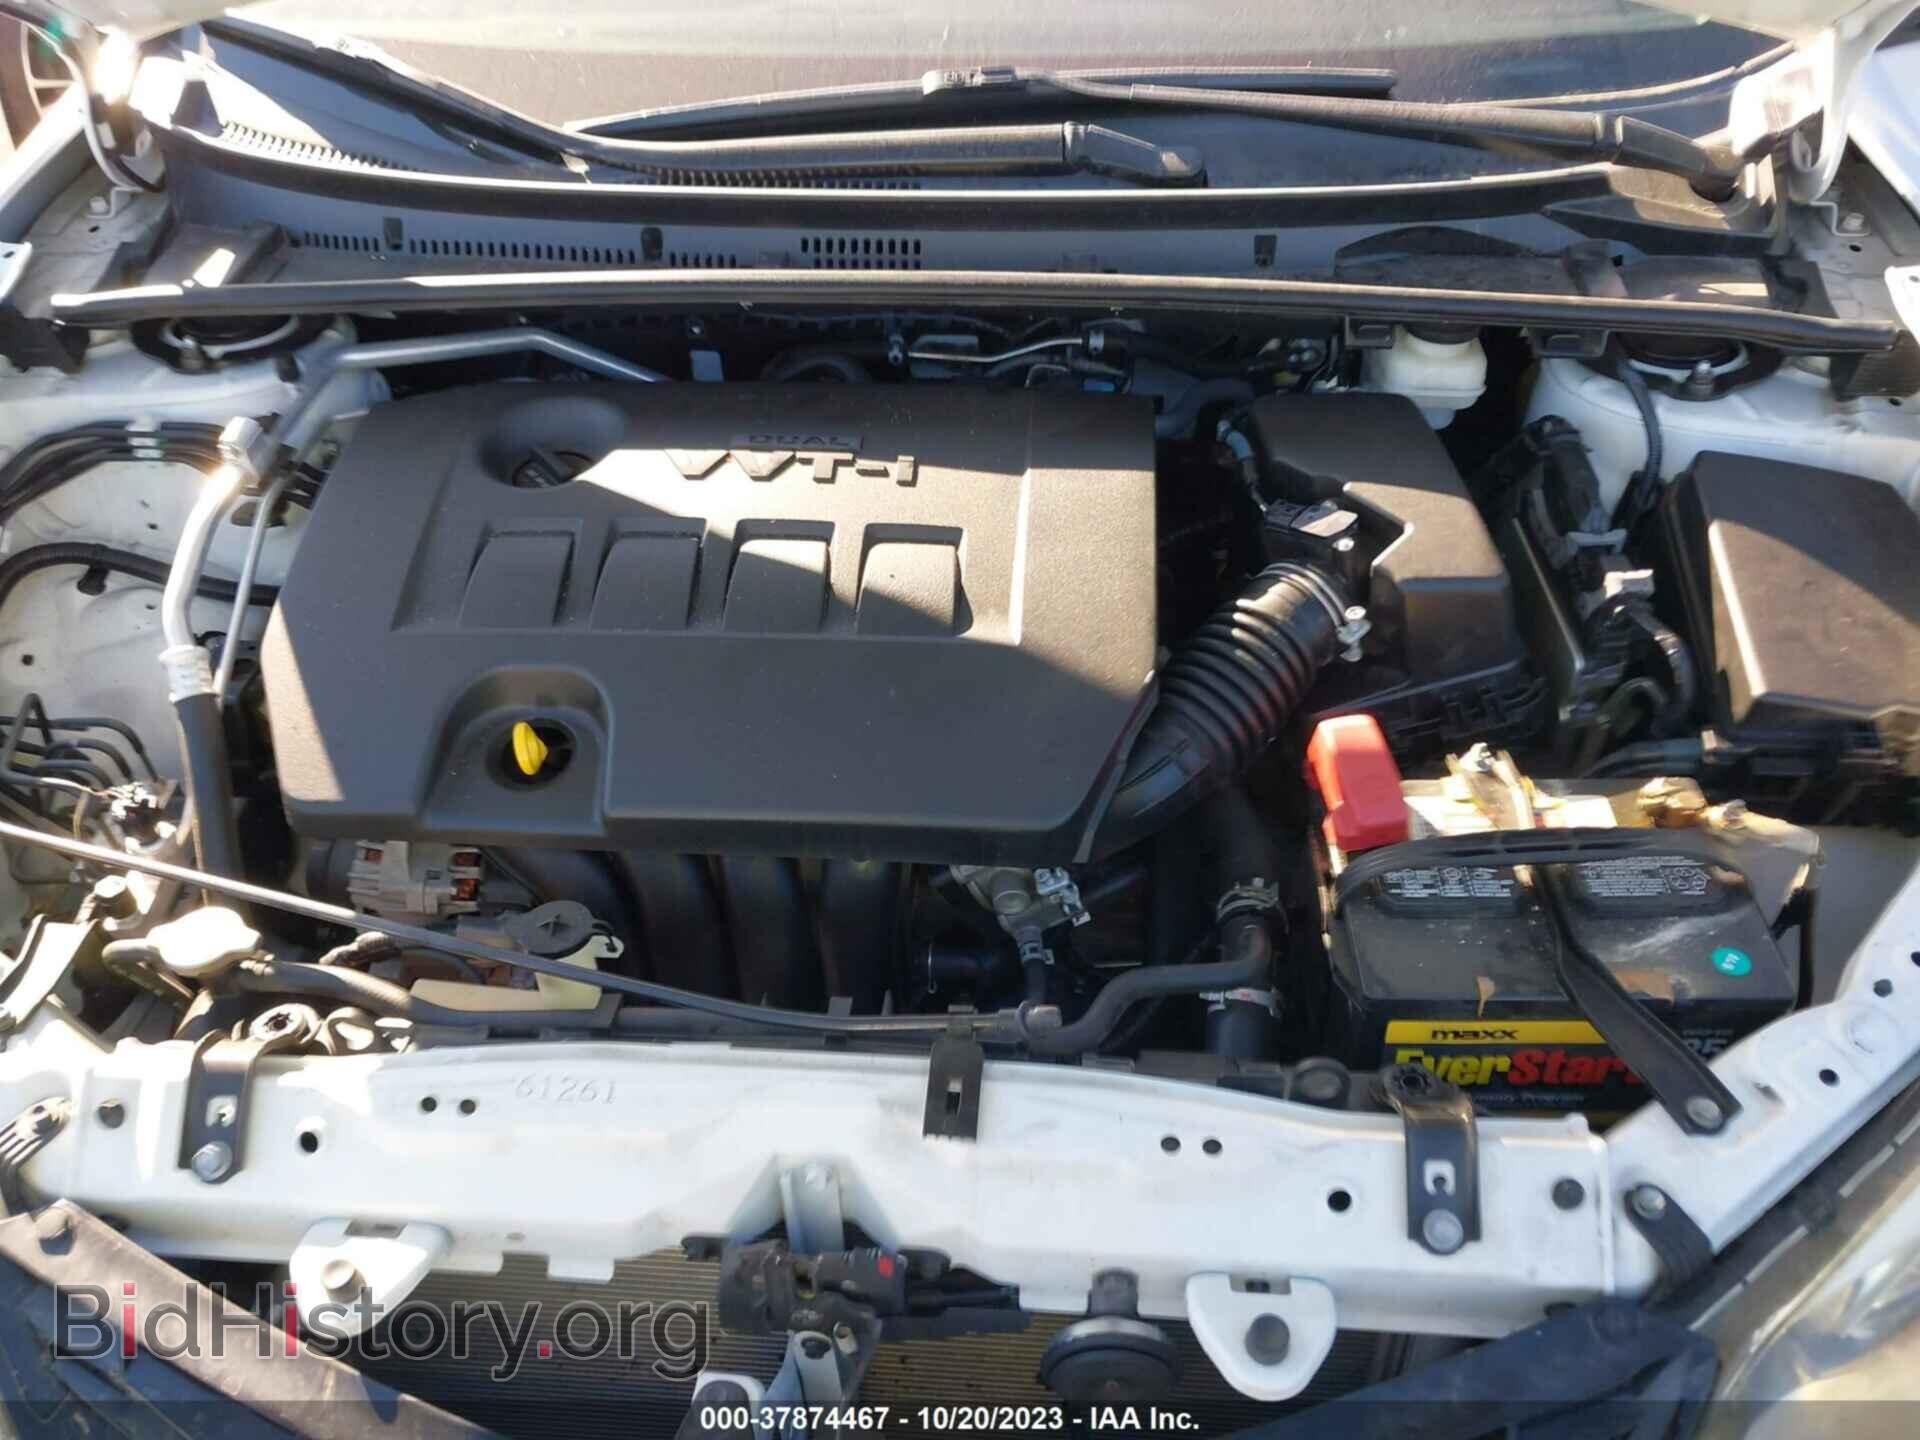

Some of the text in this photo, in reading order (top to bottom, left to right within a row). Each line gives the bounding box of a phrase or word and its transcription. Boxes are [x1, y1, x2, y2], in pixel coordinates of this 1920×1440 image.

[748, 433, 852, 449] DUAL
[1431, 1029, 1519, 1041] maxx
[1393, 1048, 1643, 1086] verStar
[515, 1073, 617, 1105] 61261
